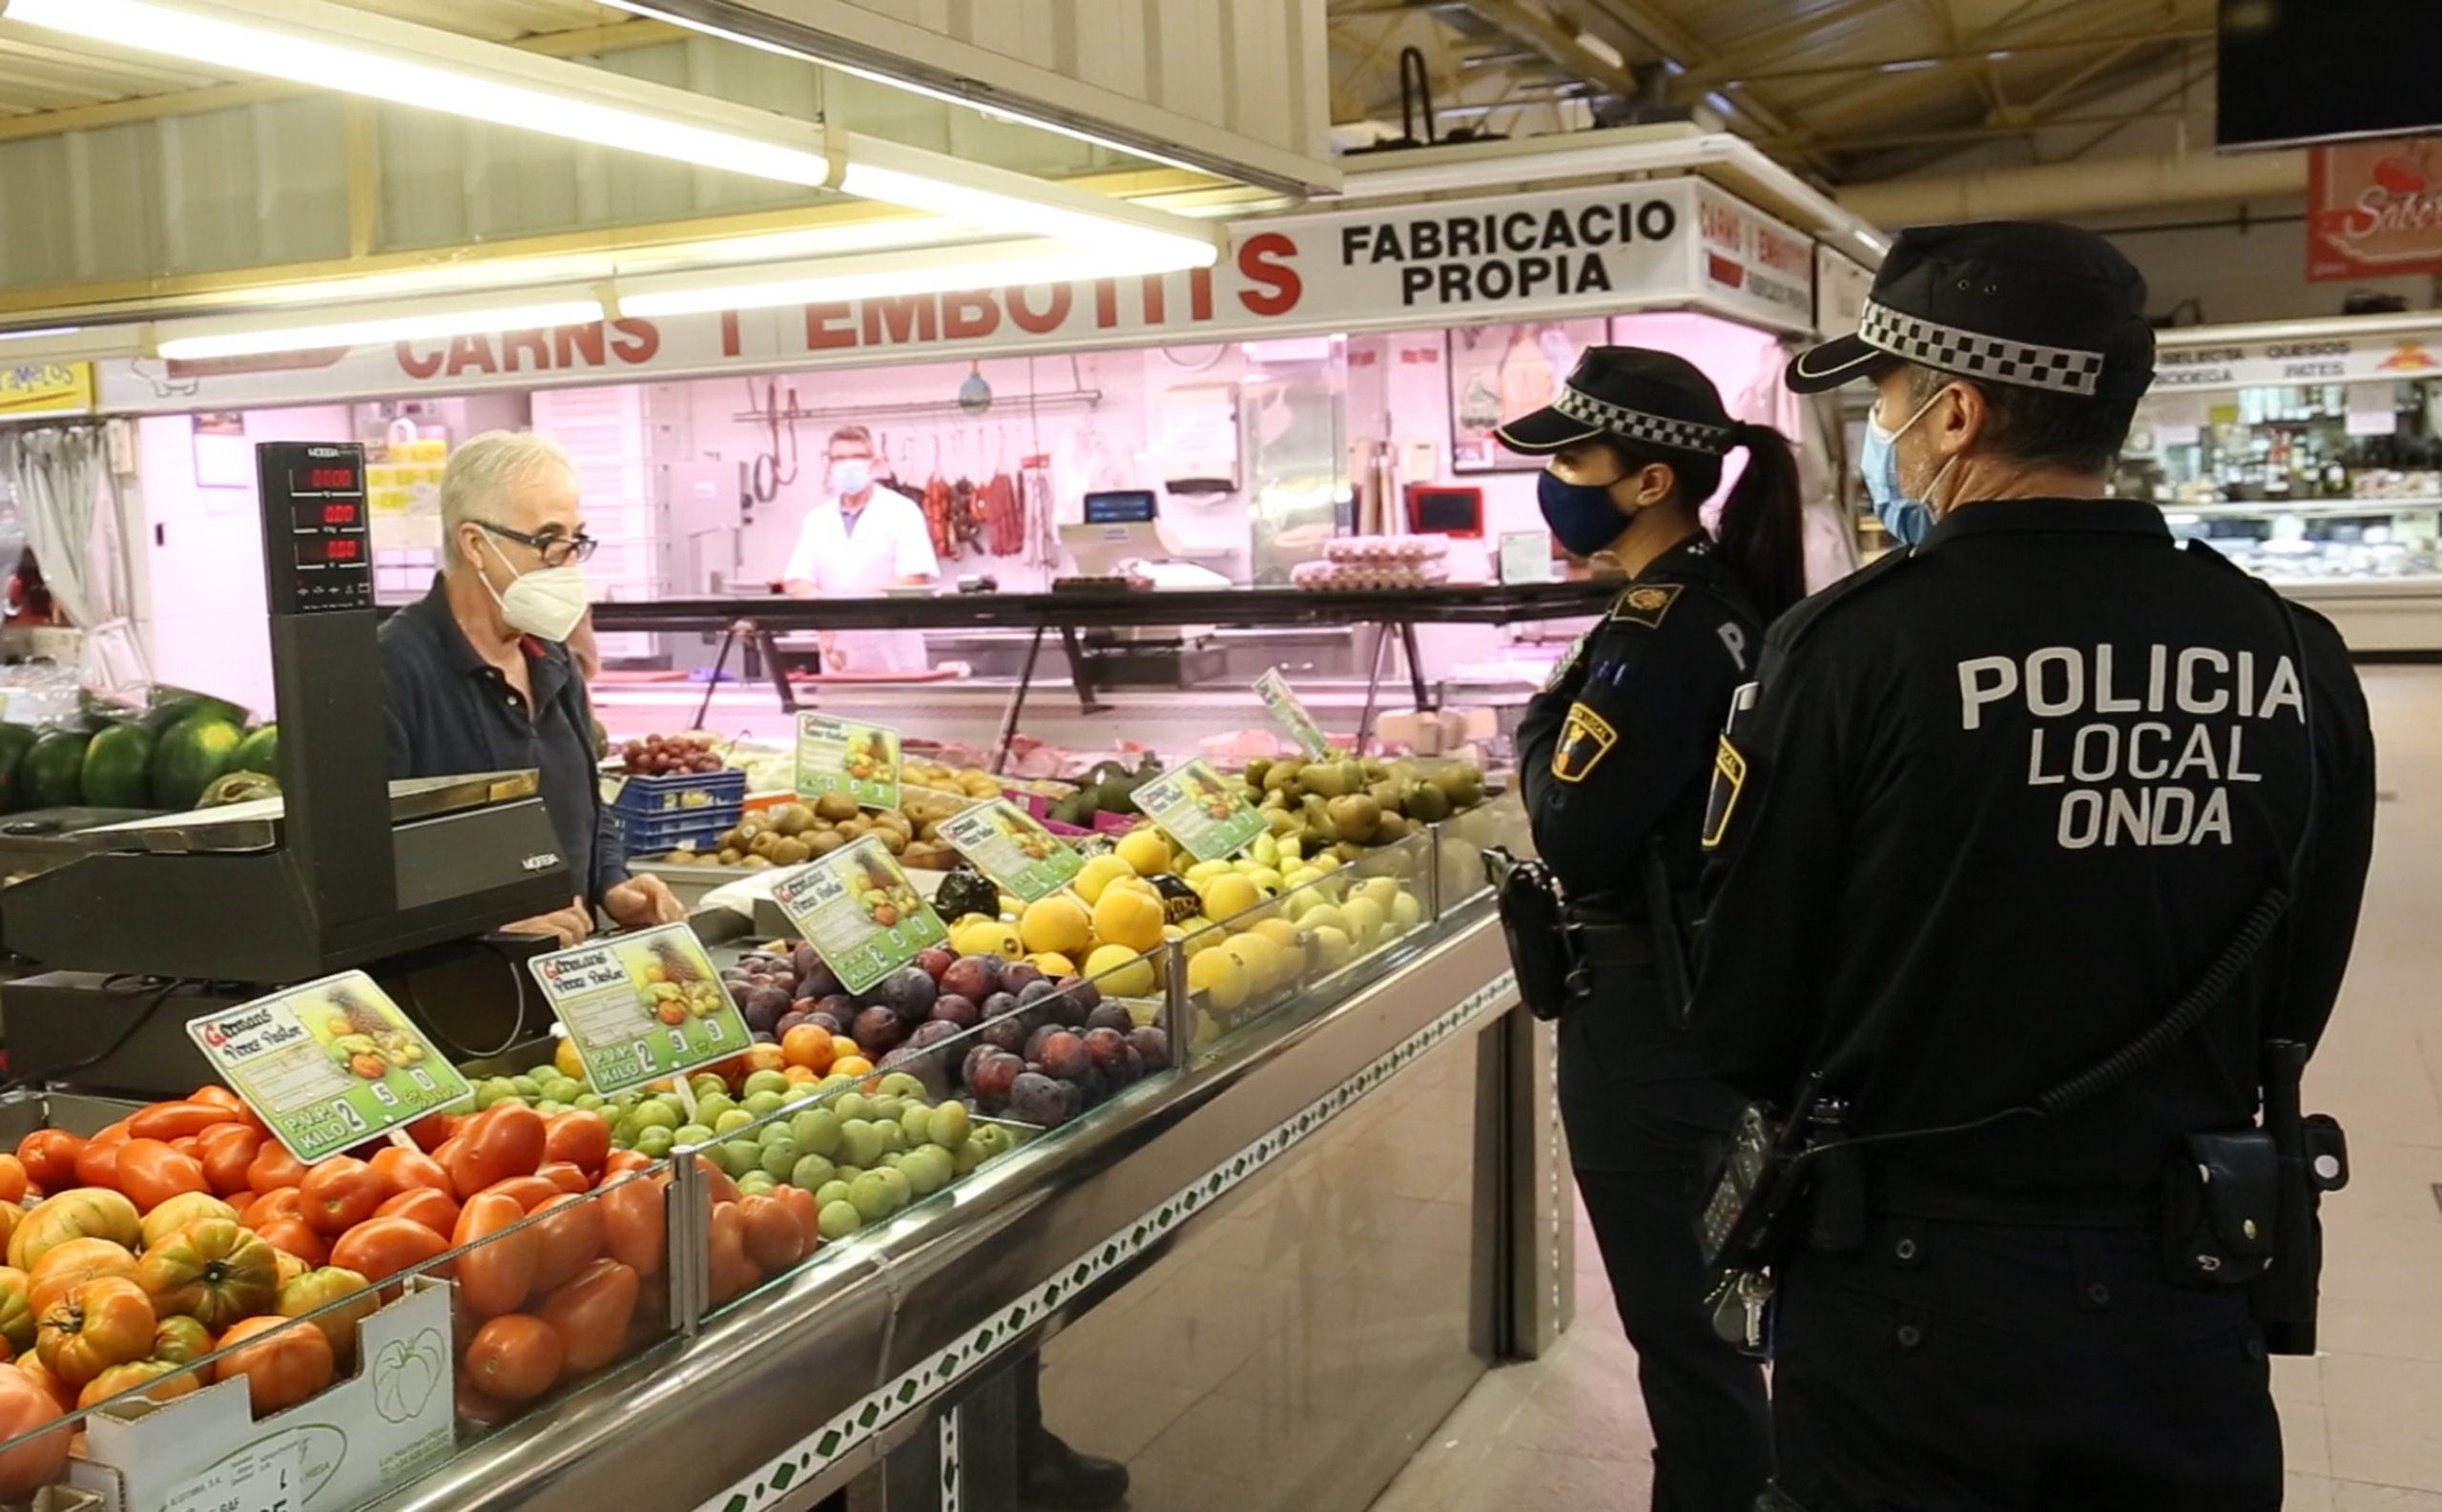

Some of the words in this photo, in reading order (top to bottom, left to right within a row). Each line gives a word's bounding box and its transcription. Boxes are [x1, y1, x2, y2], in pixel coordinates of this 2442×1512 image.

[1341, 199, 1676, 266] FABRICACIO
[1401, 252, 1612, 306] PROPIA
[1957, 644, 2306, 731] POLICIA
[2028, 722, 2263, 785] LOCAL
[2058, 786, 2233, 850] ONDA
[637, 1042, 655, 1067] 2
[300, 1121, 347, 1150] KILO
[337, 1102, 362, 1128] 2
[376, 1086, 395, 1104] 5
